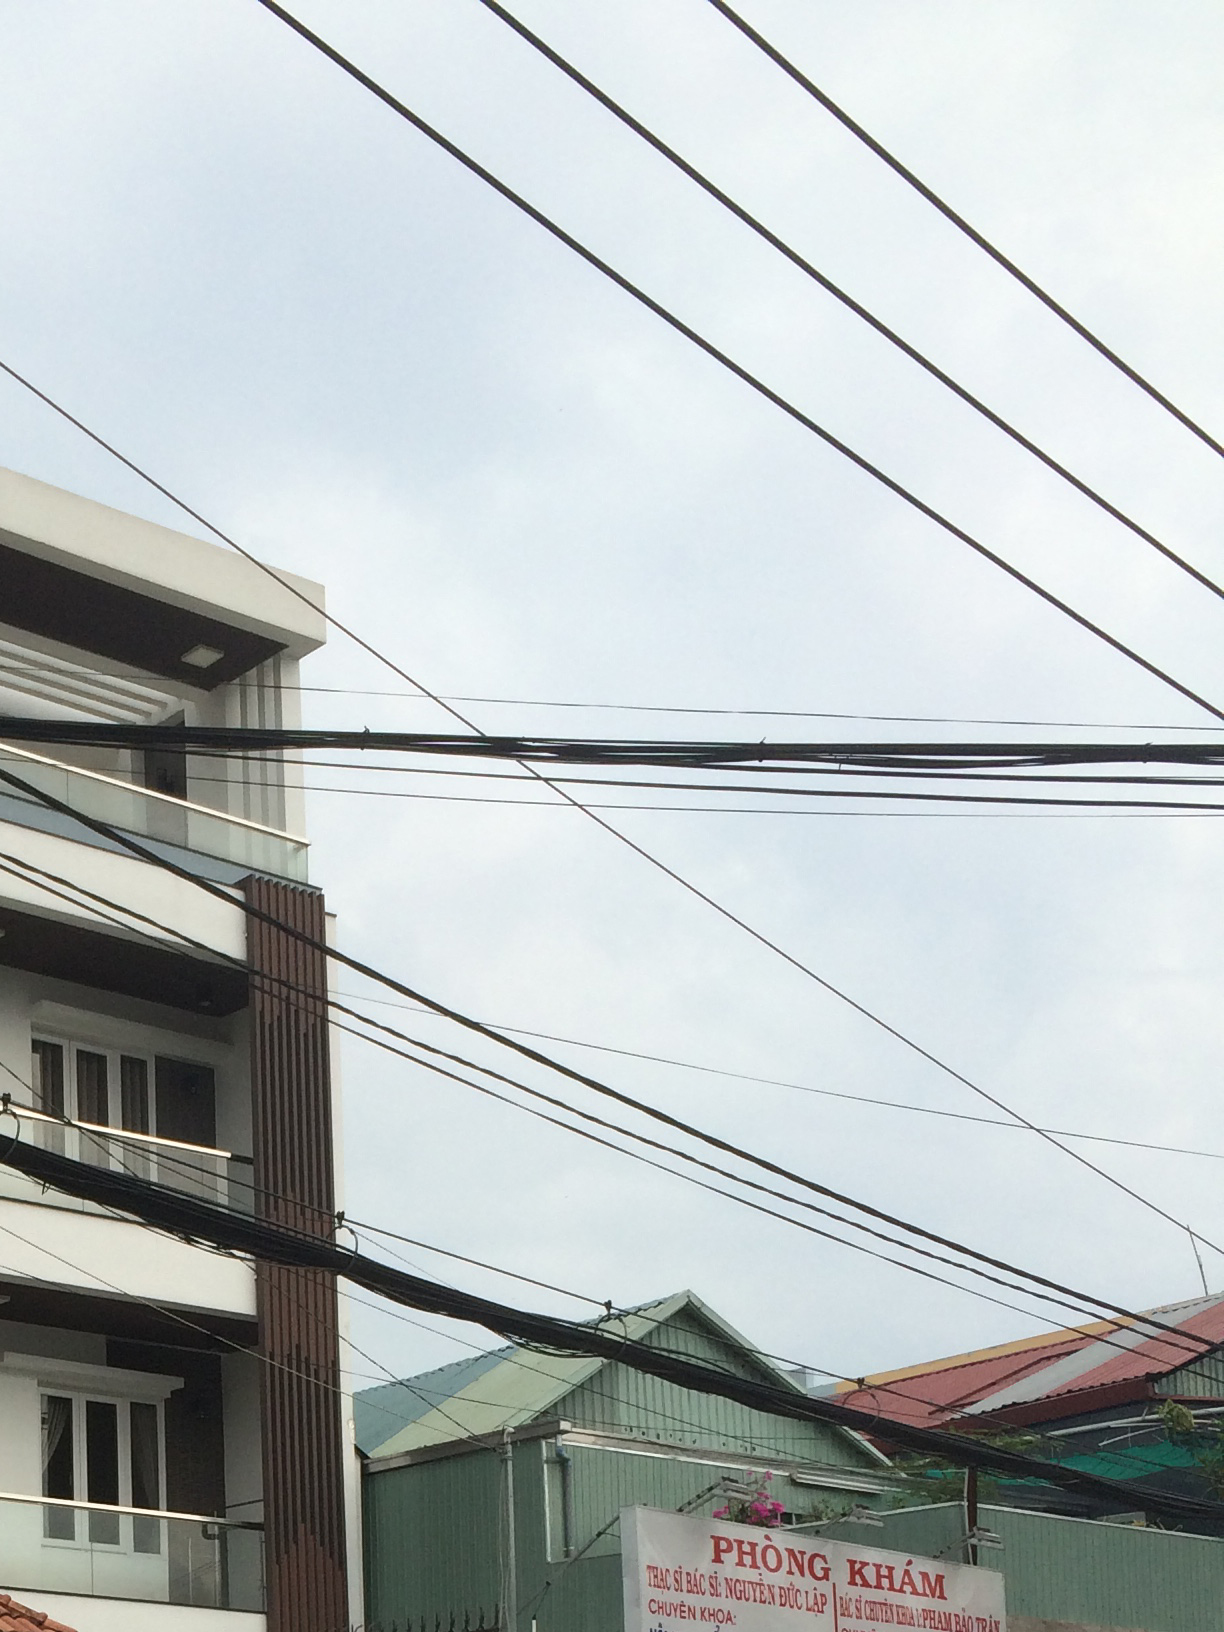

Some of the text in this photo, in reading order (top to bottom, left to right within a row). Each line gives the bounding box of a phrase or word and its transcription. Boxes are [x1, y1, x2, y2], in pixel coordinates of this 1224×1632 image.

[686, 1567, 706, 1595] BÁC
[778, 1582, 802, 1609] ĐỨC
[805, 1587, 828, 1617] LẬP
[710, 1534, 948, 1600] PHÒNG KHÁM
[648, 1599, 696, 1620] CHUYÊN
